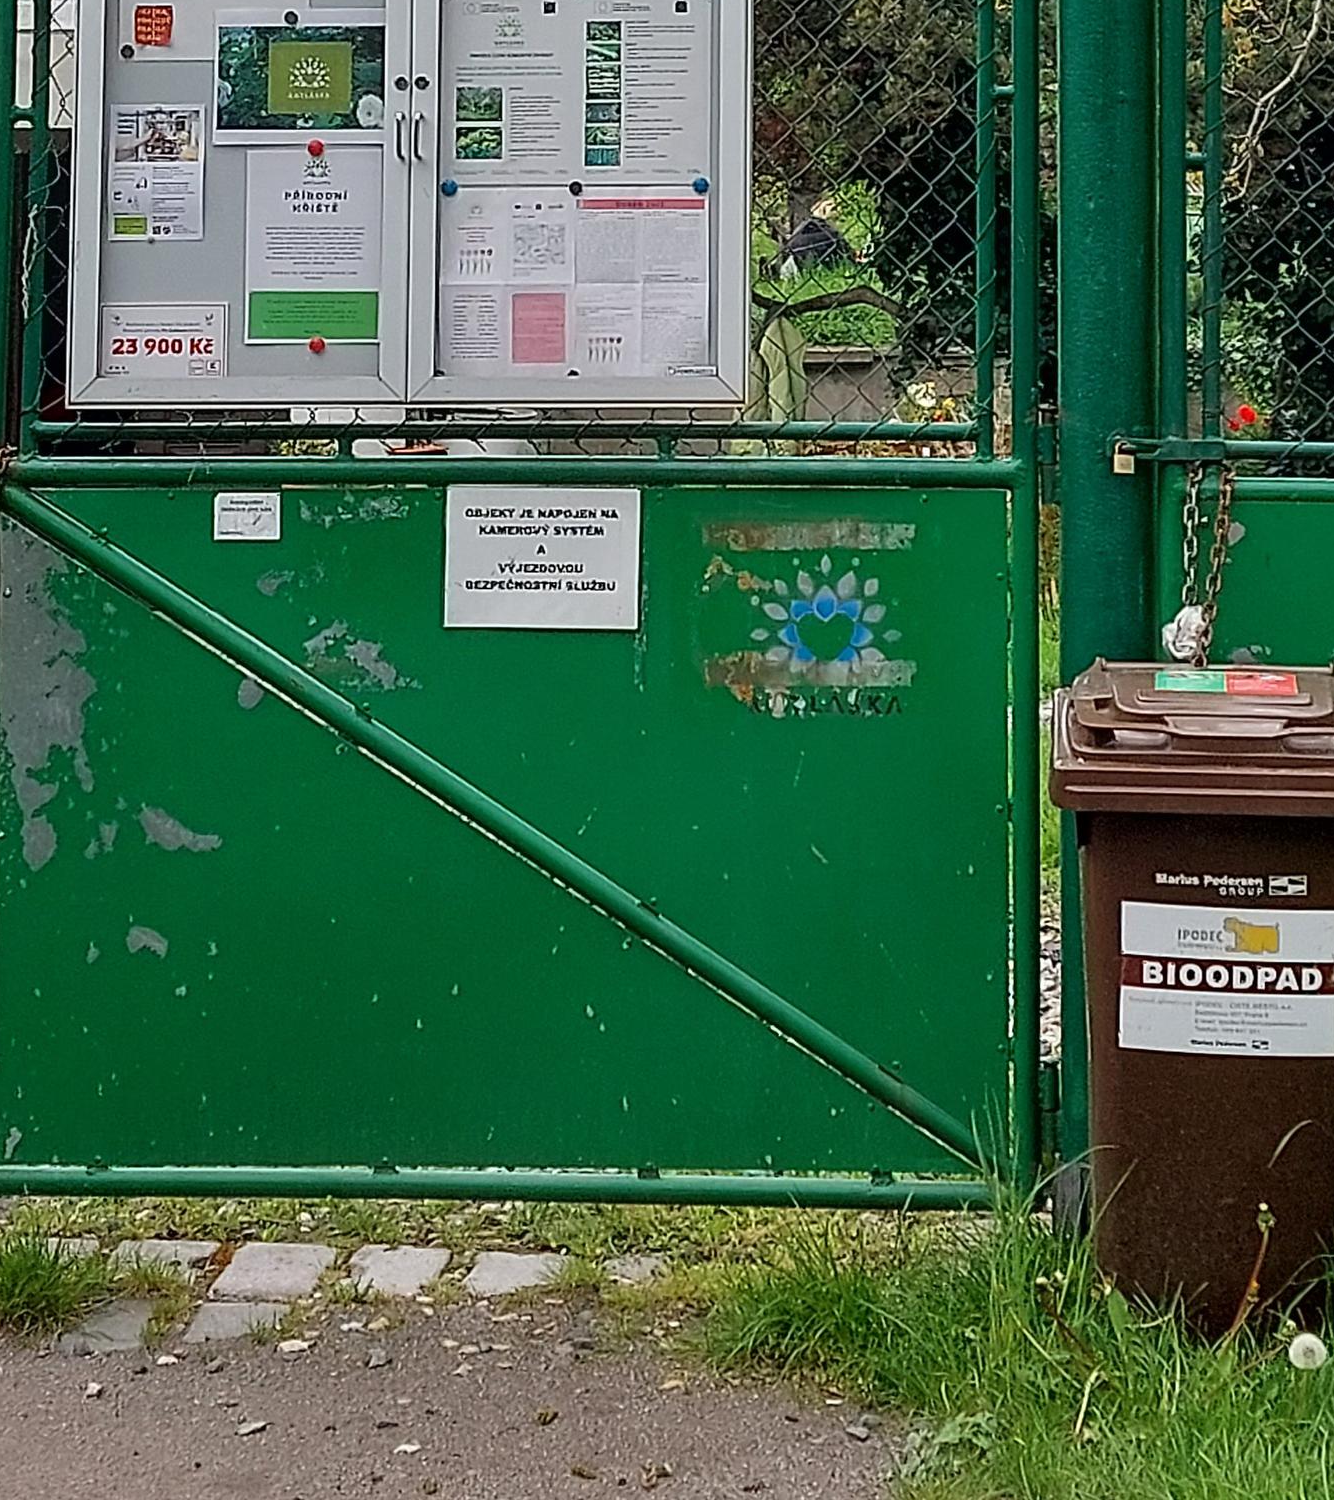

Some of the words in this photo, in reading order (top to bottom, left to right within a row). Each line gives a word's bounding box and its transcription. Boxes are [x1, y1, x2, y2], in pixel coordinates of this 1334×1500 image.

[112, 338, 138, 355] 23
[144, 338, 183, 356] 900
[189, 337, 214, 356] Kč
[519, 508, 534, 519] JE
[537, 508, 597, 519] NAPOJEN
[600, 509, 619, 519] NA
[478, 524, 550, 536] KAMEROVÝ
[553, 524, 605, 536] SYSTÉM
[536, 544, 546, 555] A
[497, 562, 584, 574] VÝJEZDOVOU
[465, 578, 562, 590] BEZPEČNOSTNÍ
[1154, 873, 1201, 886] Marius
[1203, 874, 1265, 888] Pedersen
[1218, 887, 1265, 897] GROUP
[1177, 927, 1224, 942] IPODEC
[1141, 960, 1324, 992] BIOODPAD
